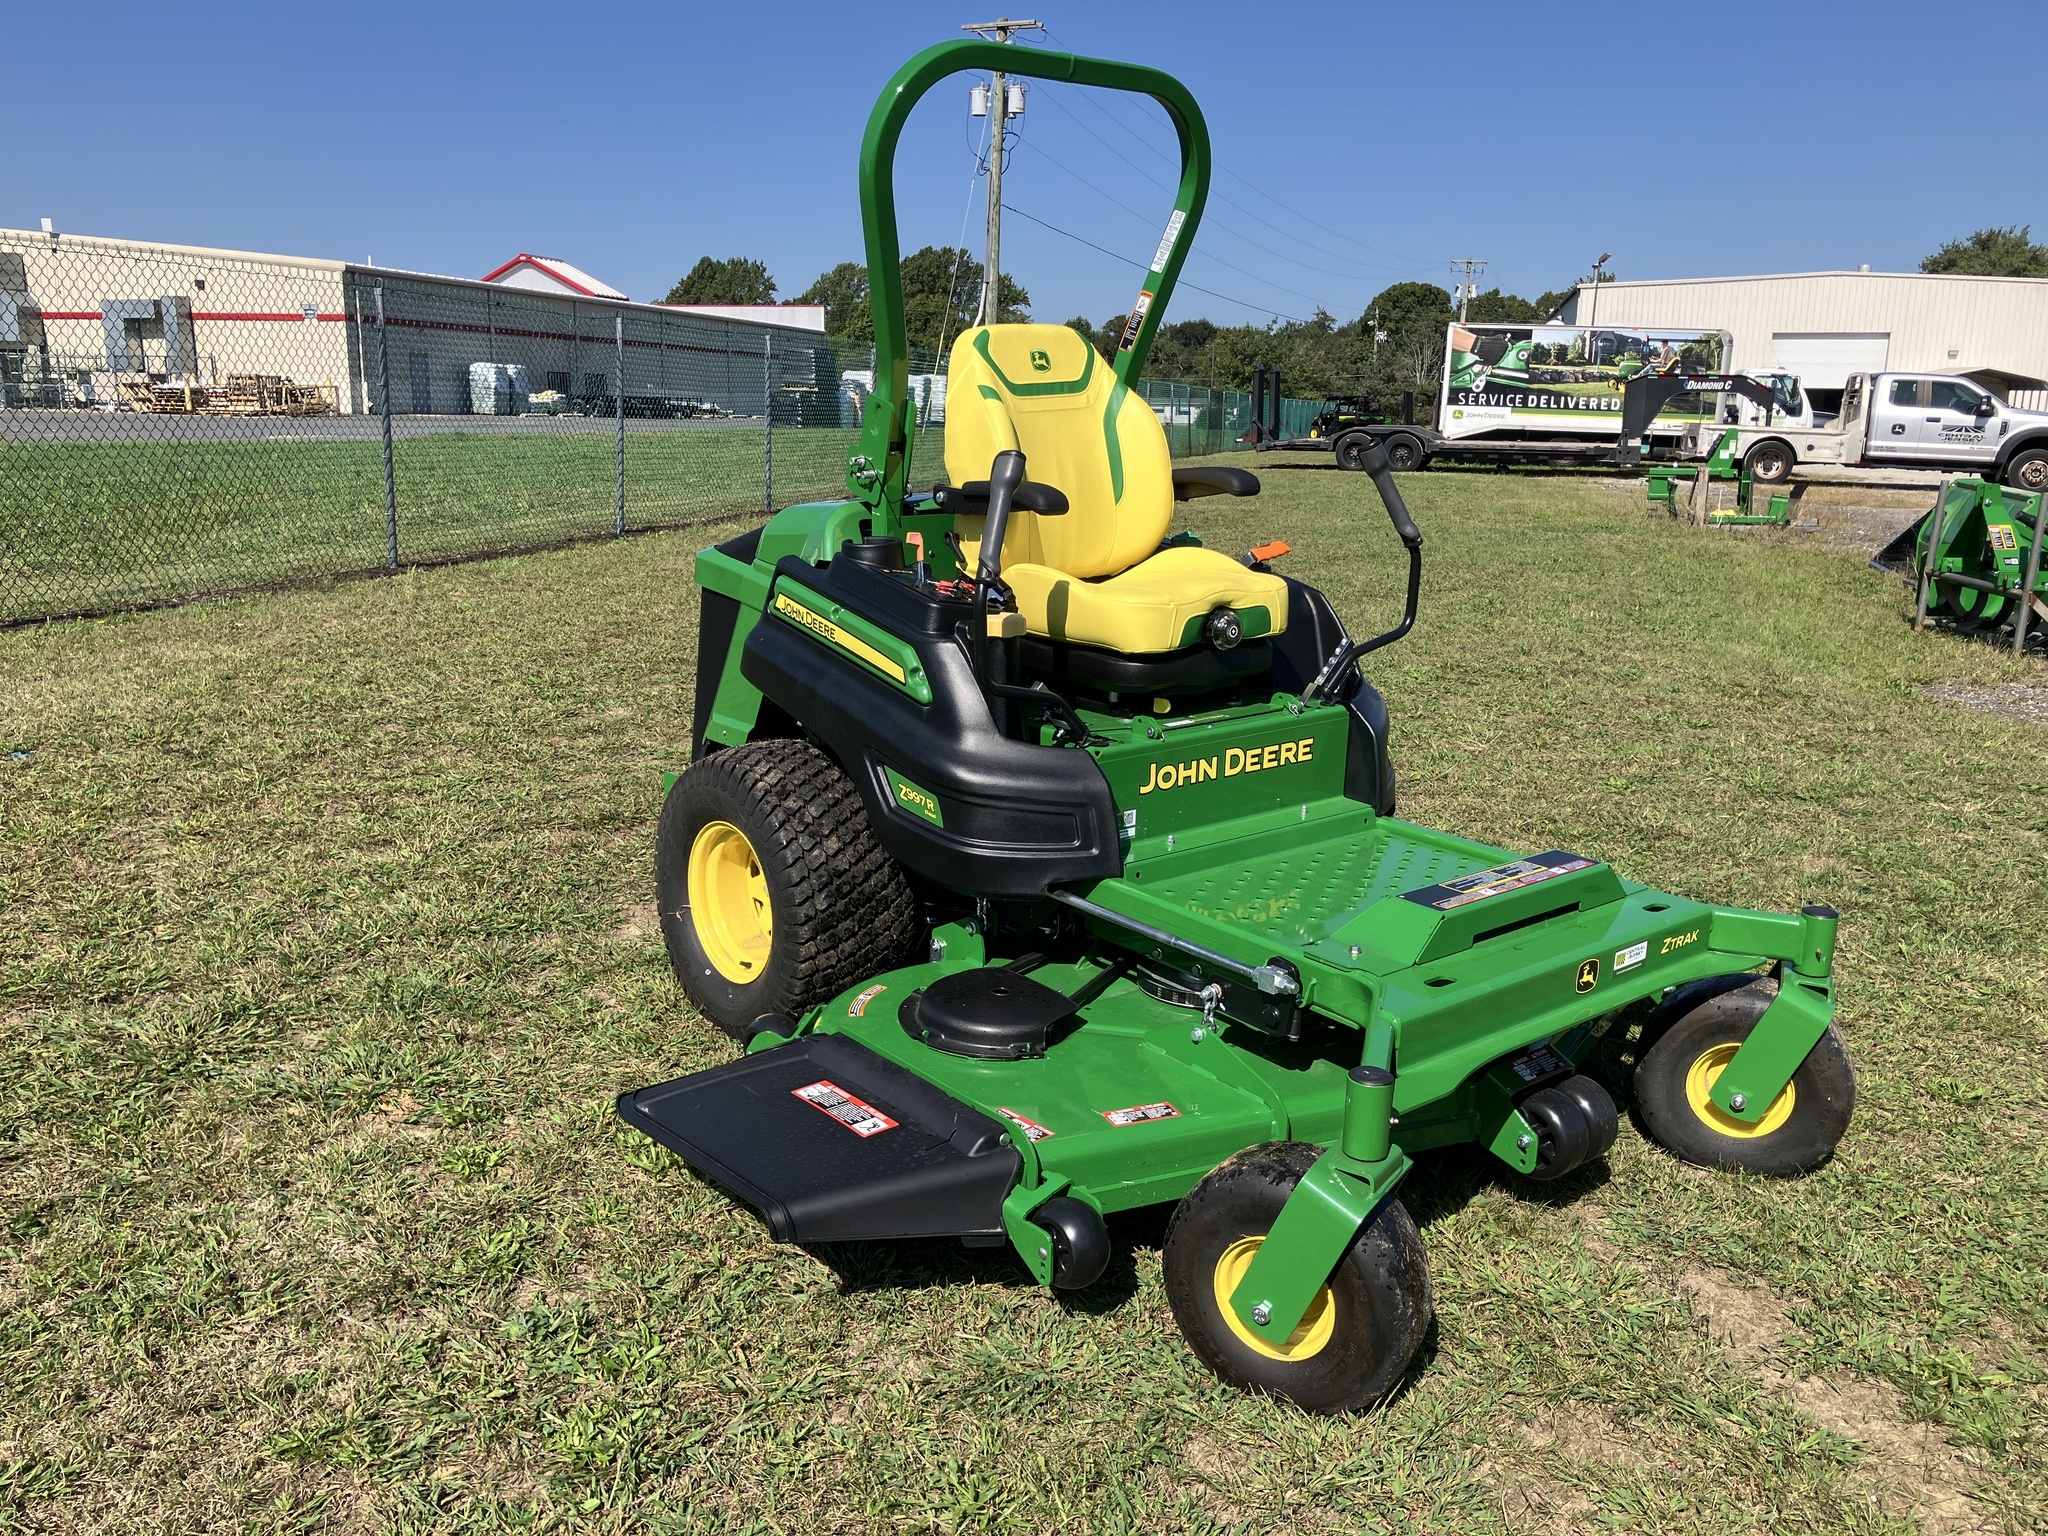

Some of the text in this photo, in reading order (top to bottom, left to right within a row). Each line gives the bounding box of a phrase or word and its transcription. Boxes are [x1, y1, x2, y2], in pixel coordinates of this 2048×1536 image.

[1687, 380, 1733, 390] DIAMOND C
[1458, 392, 1621, 411] SERVICE DELIVERED
[781, 599, 836, 641] JOHN DEERE
[1139, 737, 1314, 795] JOHN DEERE
[1627, 945, 1646, 956] CENTRAL
[1660, 928, 1700, 955] ZTRAK
